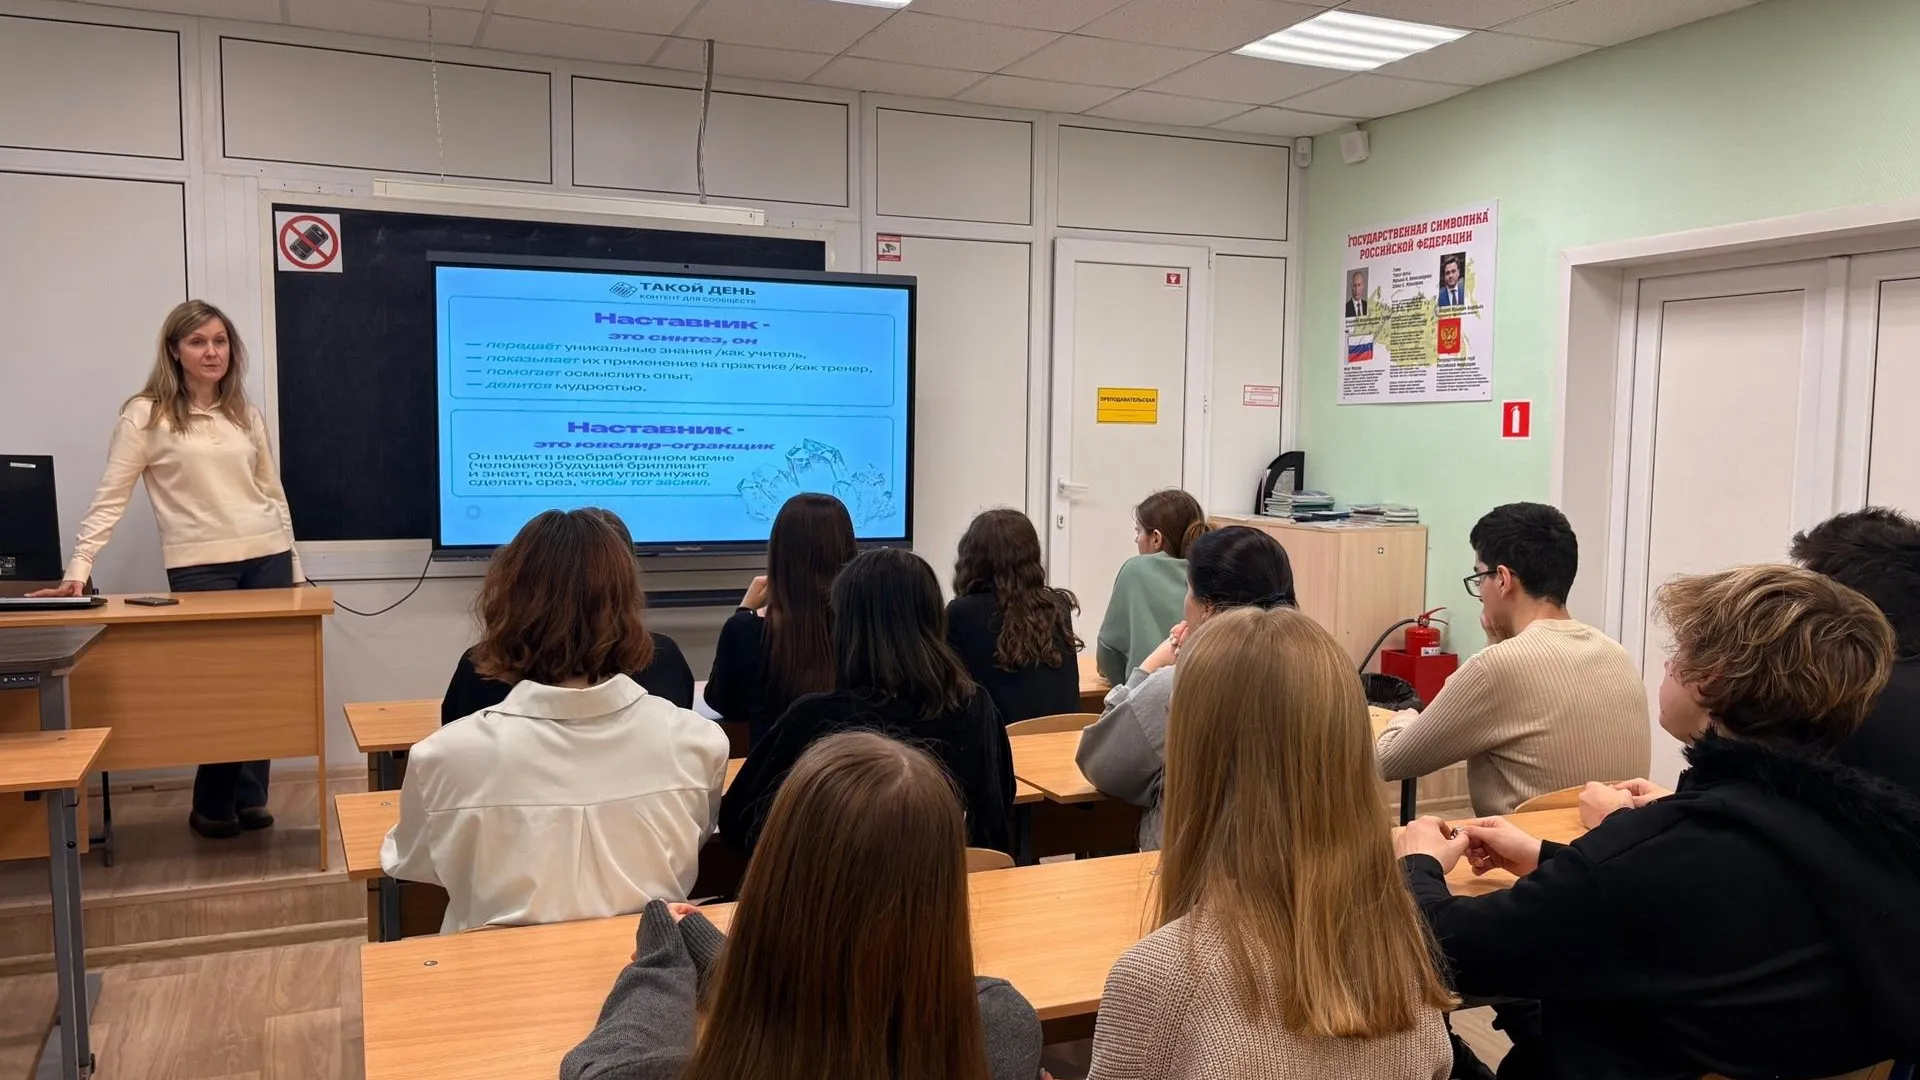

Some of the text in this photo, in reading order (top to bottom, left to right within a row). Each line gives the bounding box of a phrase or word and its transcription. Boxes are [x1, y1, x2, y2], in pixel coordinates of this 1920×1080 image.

[1348, 211, 1489, 247] ГОСУДАРСТВЕННАЯ СИМВОЛИКА
[1359, 230, 1473, 260] РОССИЙСКОЙ ФЕДЕРАЦИИ
[640, 282, 756, 297] ТАКОЙ ДЕНЬ
[594, 312, 758, 330] Наставник
[608, 333, 645, 341] это
[648, 335, 728, 345] синтез,
[486, 341, 562, 351] передаёт
[564, 344, 657, 354] уникальные
[659, 347, 712, 356] знания
[715, 348, 745, 358] /как
[486, 355, 580, 365] показывает
[603, 358, 698, 368] применение
[721, 362, 787, 371] практике
[789, 363, 818, 372] /как
[486, 368, 562, 377] помогает
[564, 370, 651, 379] осмыслить
[485, 382, 553, 390] делится
[555, 383, 647, 392] мудростью.
[567, 422, 733, 435] Наставник
[533, 441, 571, 449] это
[468, 452, 491, 461] Он
[494, 454, 543, 462] видит
[557, 452, 686, 462] необработанном
[627, 462, 708, 471] бриллиант
[616, 471, 661, 479] углом
[664, 471, 710, 479] нужно
[468, 479, 533, 487] сделать
[580, 478, 627, 486] чтобы
